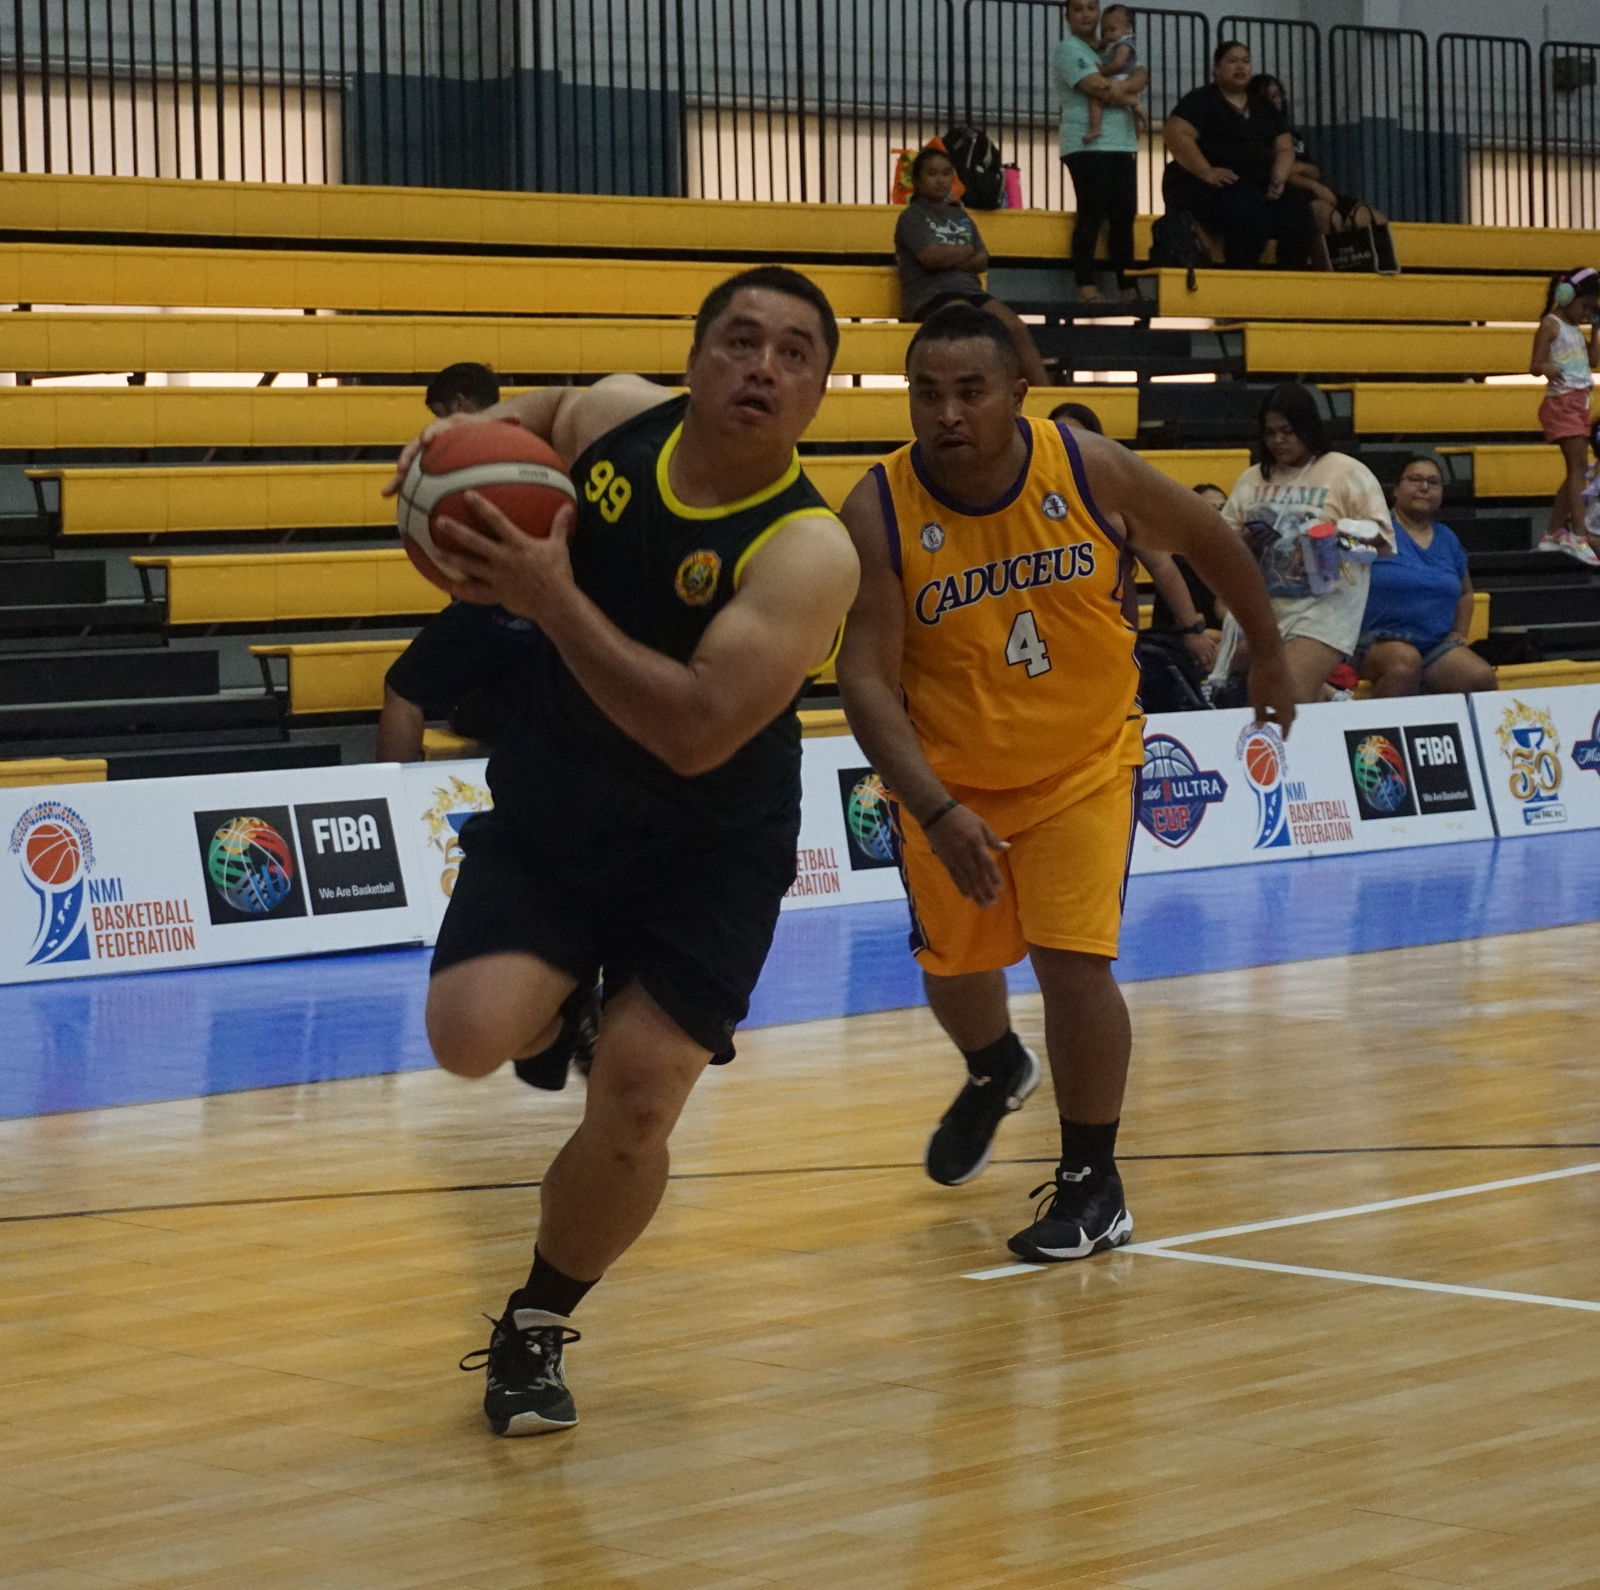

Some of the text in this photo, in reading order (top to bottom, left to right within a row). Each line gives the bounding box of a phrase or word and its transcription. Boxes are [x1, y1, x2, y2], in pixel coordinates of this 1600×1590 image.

[585, 460, 632, 523] 99
[915, 541, 1096, 626] CADUCEUS
[1005, 609, 1052, 679] 4
[1414, 734, 1458, 767] FIBA
[1172, 778, 1222, 798] ULTRA
[1285, 781, 1308, 802] NMI
[1152, 805, 1190, 832] CUP
[1289, 800, 1350, 824] BASKETBALL
[312, 813, 381, 855] FIBA
[1293, 821, 1354, 845] FEDERATION
[796, 847, 839, 872] ETBALL
[88, 877, 124, 904] NMI
[318, 881, 396, 900] We Are Basketball
[784, 871, 841, 898] ERATION
[92, 899, 194, 932] BASKETBALL
[95, 926, 196, 960] FEDERATION
